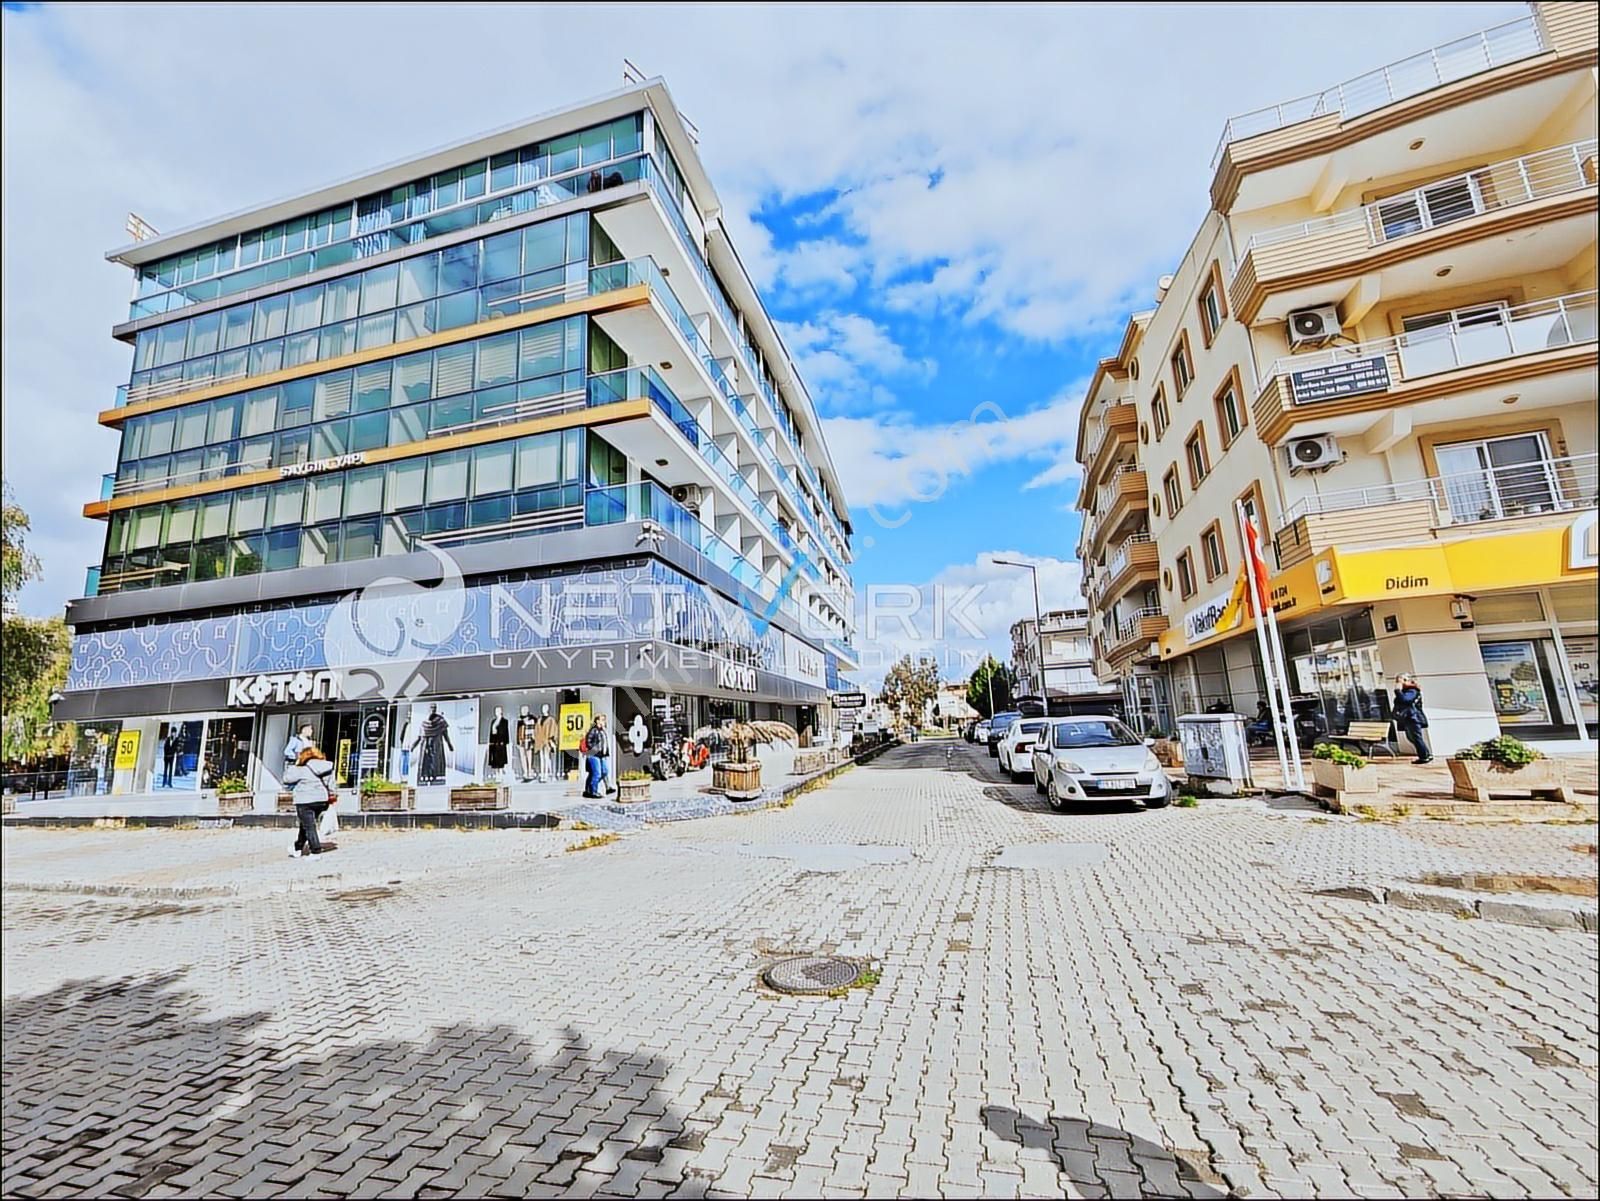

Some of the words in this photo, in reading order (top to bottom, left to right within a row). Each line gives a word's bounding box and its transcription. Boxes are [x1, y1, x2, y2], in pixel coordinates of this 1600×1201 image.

[1386, 575, 1429, 590] Didim
[227, 671, 340, 707] KOTON
[566, 714, 584, 731] 50
[120, 740, 134, 754] 50
